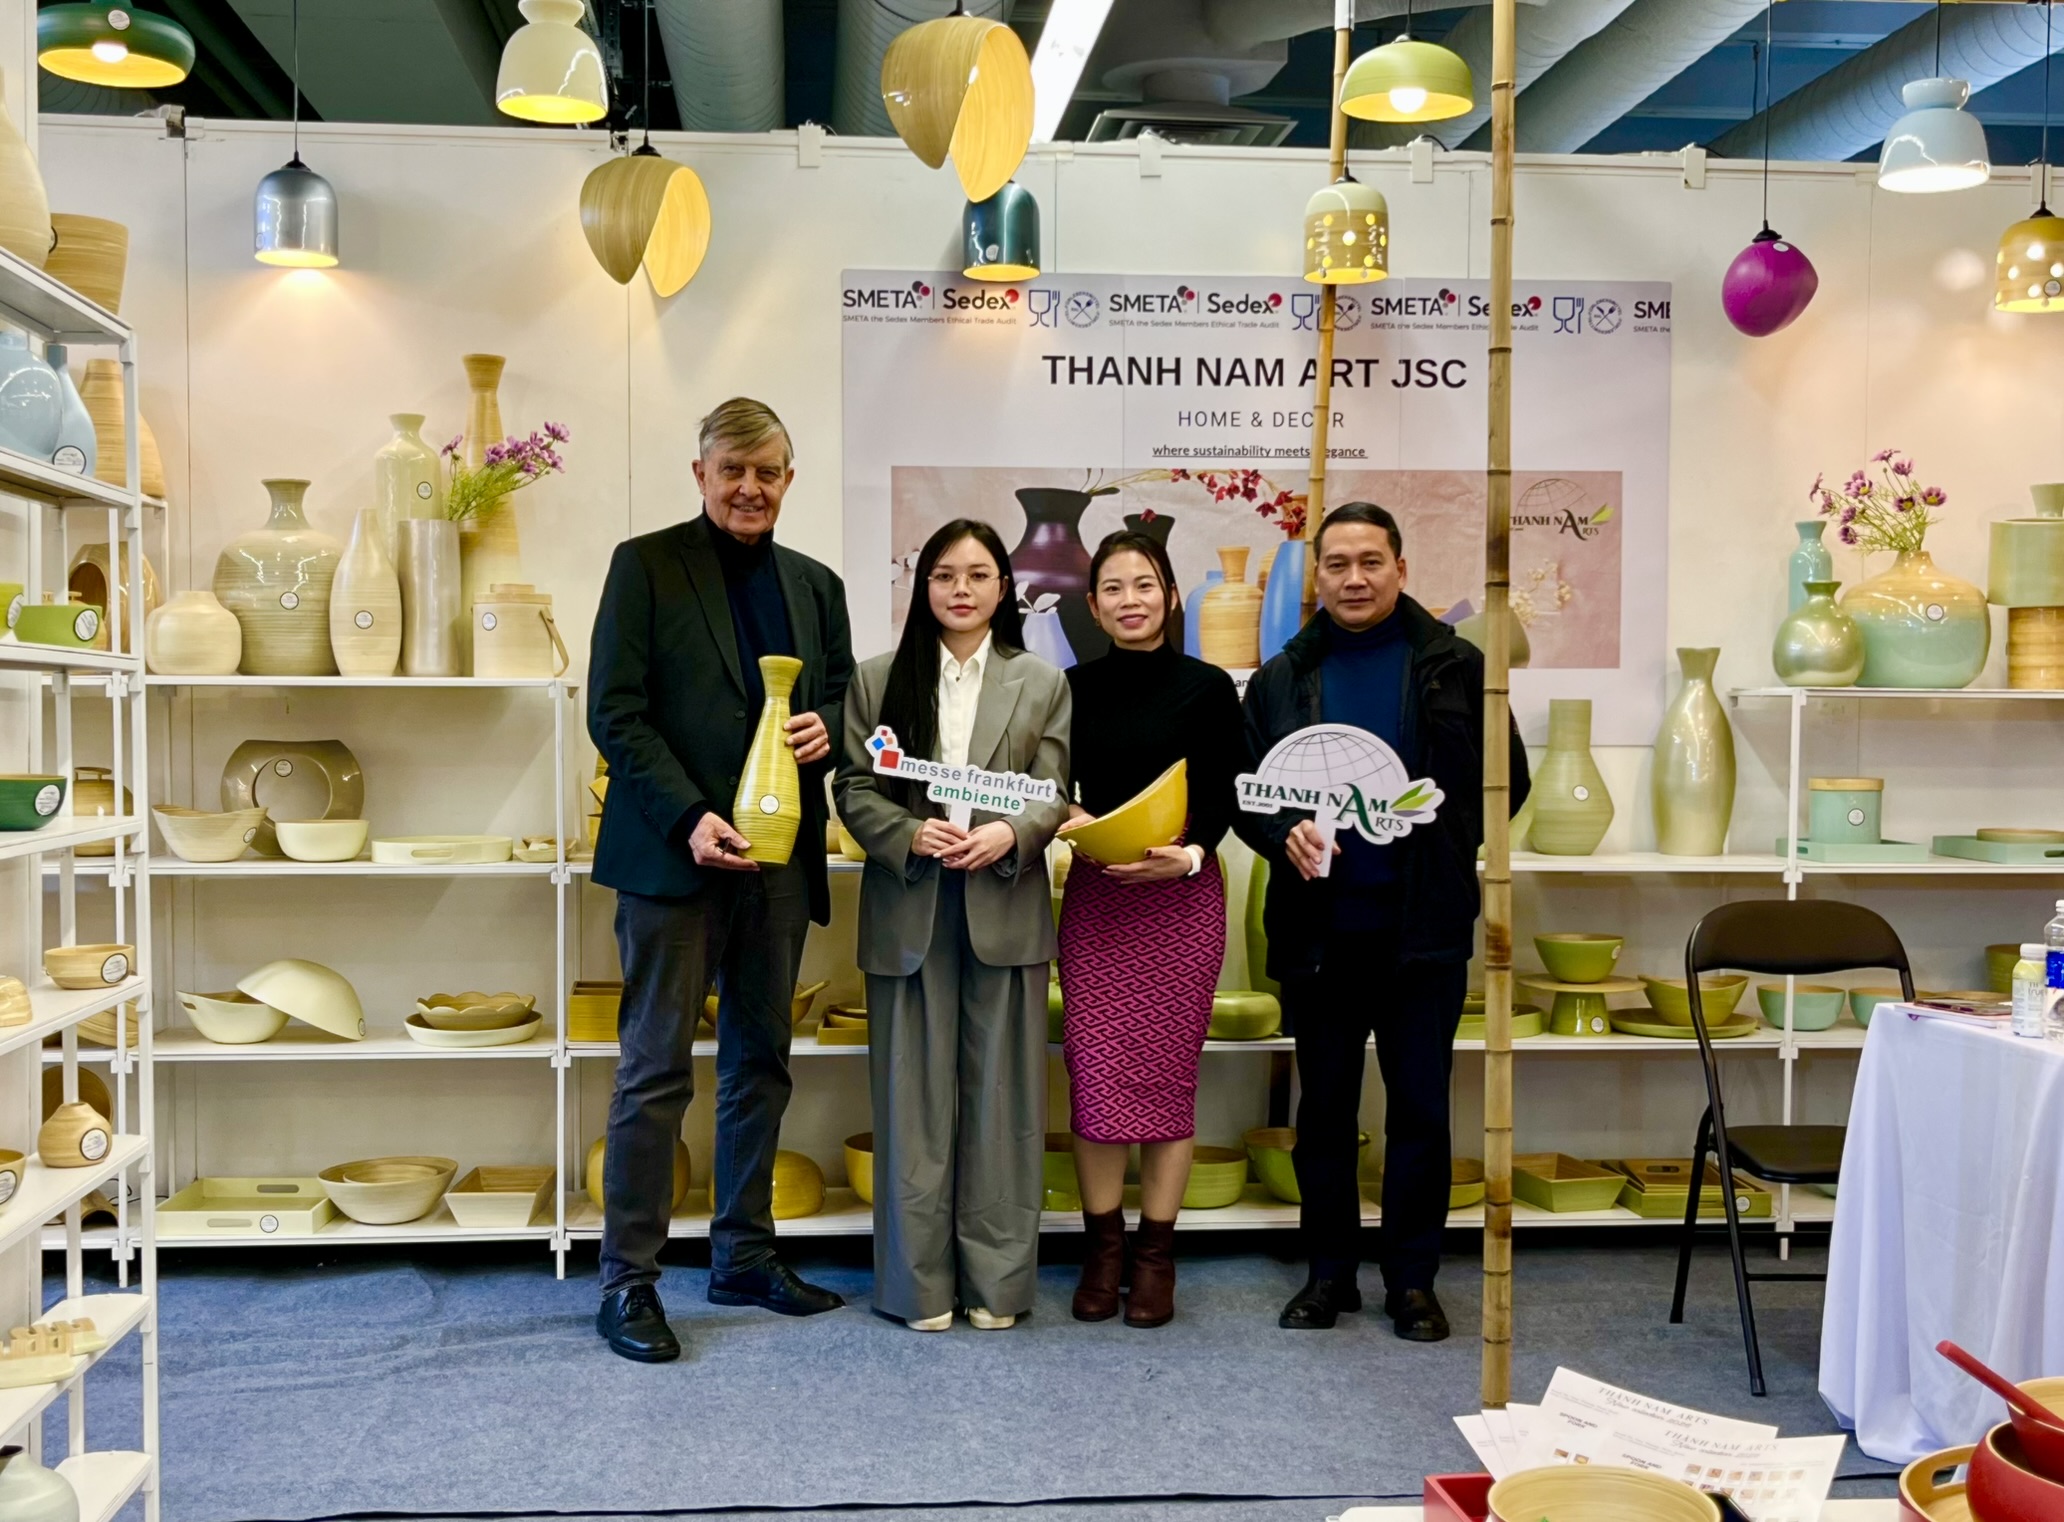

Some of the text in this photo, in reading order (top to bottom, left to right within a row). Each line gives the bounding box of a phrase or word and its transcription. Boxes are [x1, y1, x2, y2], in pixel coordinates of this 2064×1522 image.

[843, 288, 1012, 310] SMETA Sedex
[1109, 294, 1182, 313] SMETA
[1207, 293, 1275, 314] Sedex
[1371, 297, 1443, 316] SMETA
[1468, 296, 1534, 317] Seex
[909, 316, 945, 324] Members
[1150, 320, 1172, 328] Sedex
[1174, 320, 1209, 328] Members
[1259, 321, 1279, 329] Audit
[1370, 322, 1395, 330] SMETA
[1435, 323, 1469, 331] Members
[1042, 355, 1467, 388] THANH NAM ART JSC
[1178, 411, 1344, 428] HOME & DECR
[1152, 445, 1366, 458] where sustainability meets egance
[1510, 516, 1550, 526] HANH
[900, 760, 1052, 798] messe frankfurt
[933, 784, 1021, 811] ambiente
[1241, 781, 1389, 837] THANH NAM
[1644, 1402, 1672, 1415] NAM
[1677, 1412, 1709, 1425] ARTS
